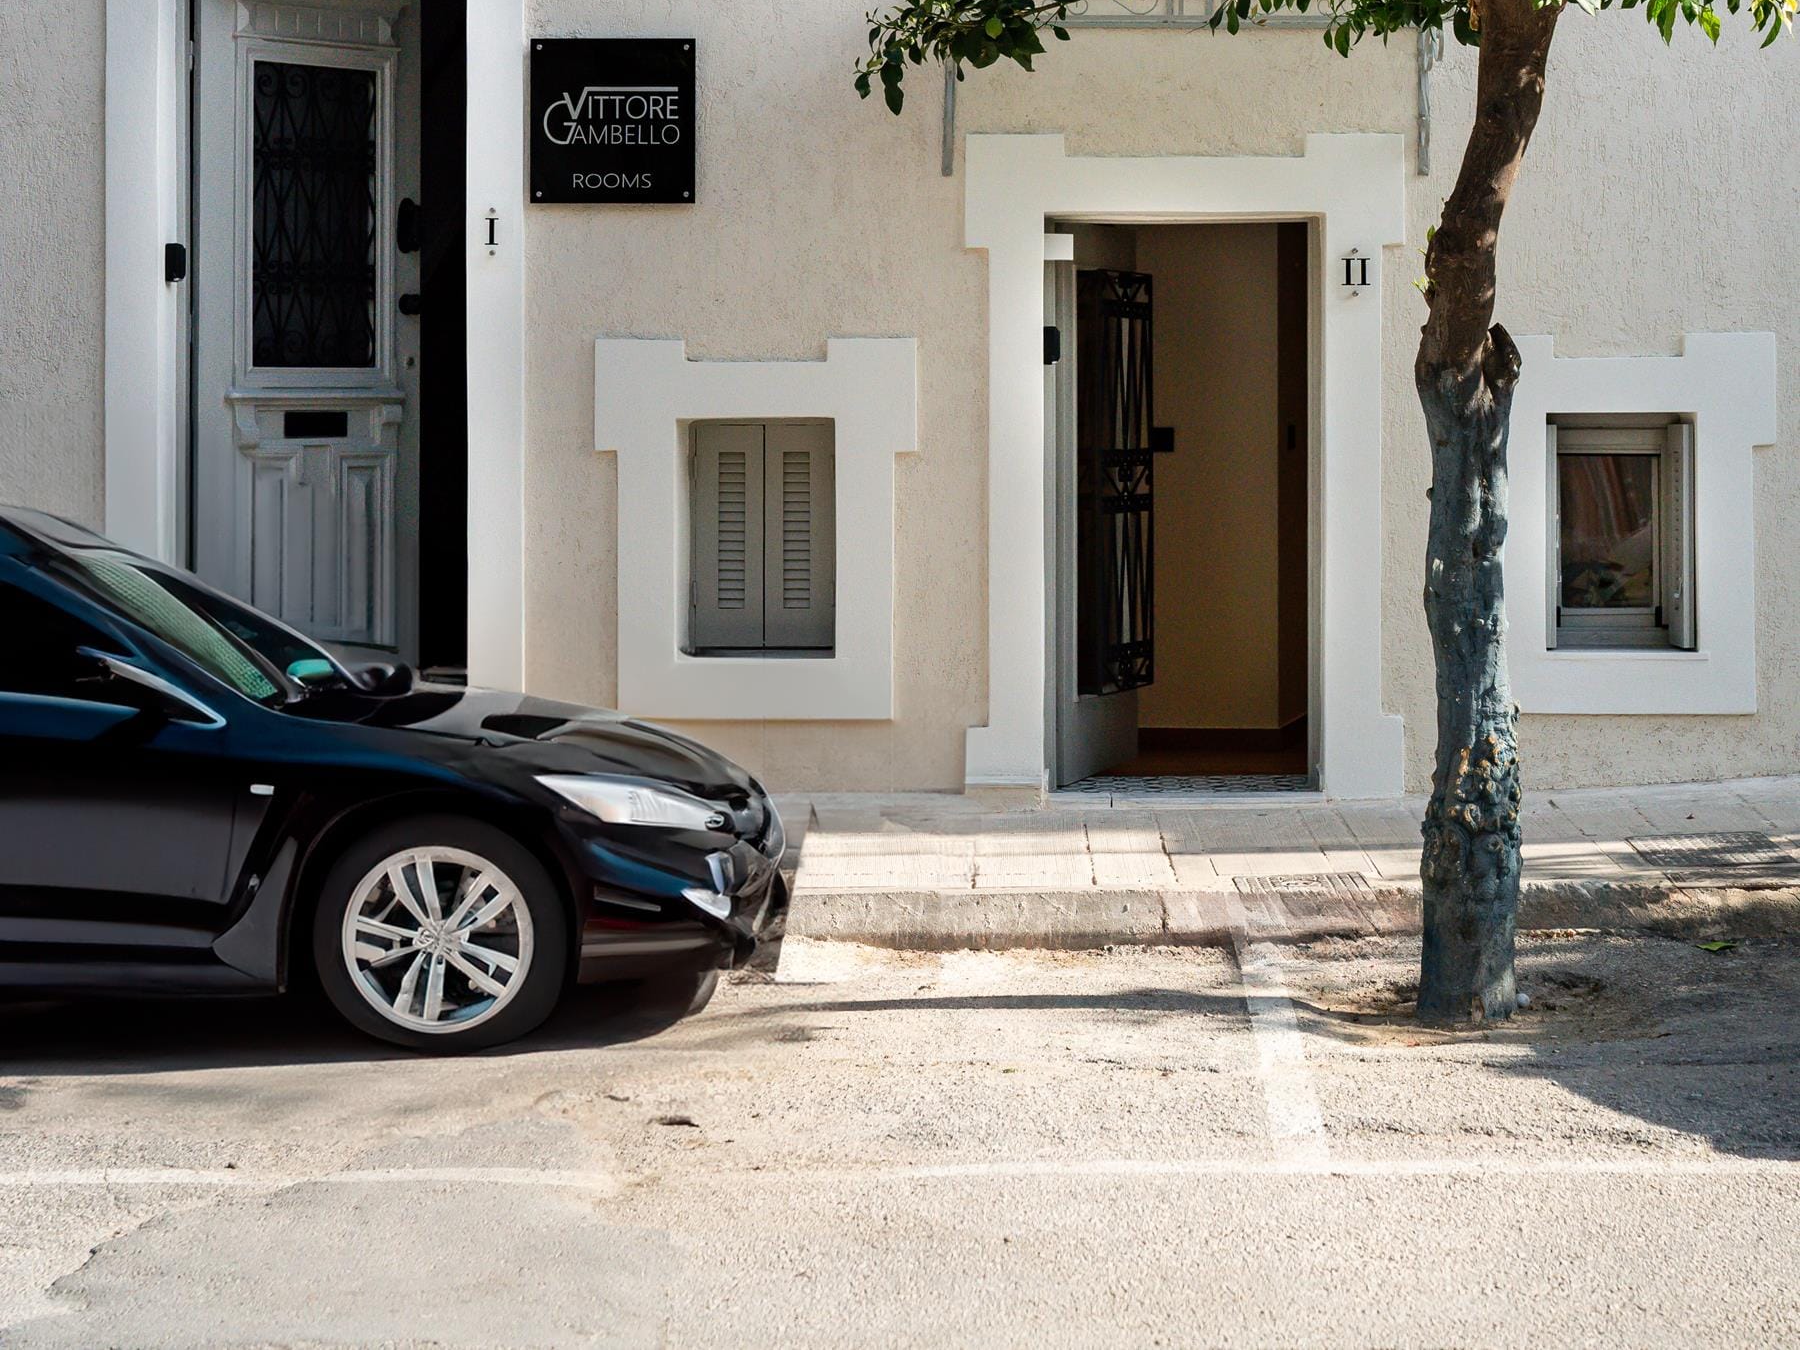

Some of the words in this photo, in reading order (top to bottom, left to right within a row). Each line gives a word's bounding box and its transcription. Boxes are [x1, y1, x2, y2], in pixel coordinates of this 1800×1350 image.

[562, 86, 679, 120] VITTORE
[543, 100, 680, 145] GAMBELLO
[573, 173, 652, 189] ROOMS
[484, 217, 499, 246] I
[1341, 257, 1371, 286] II
